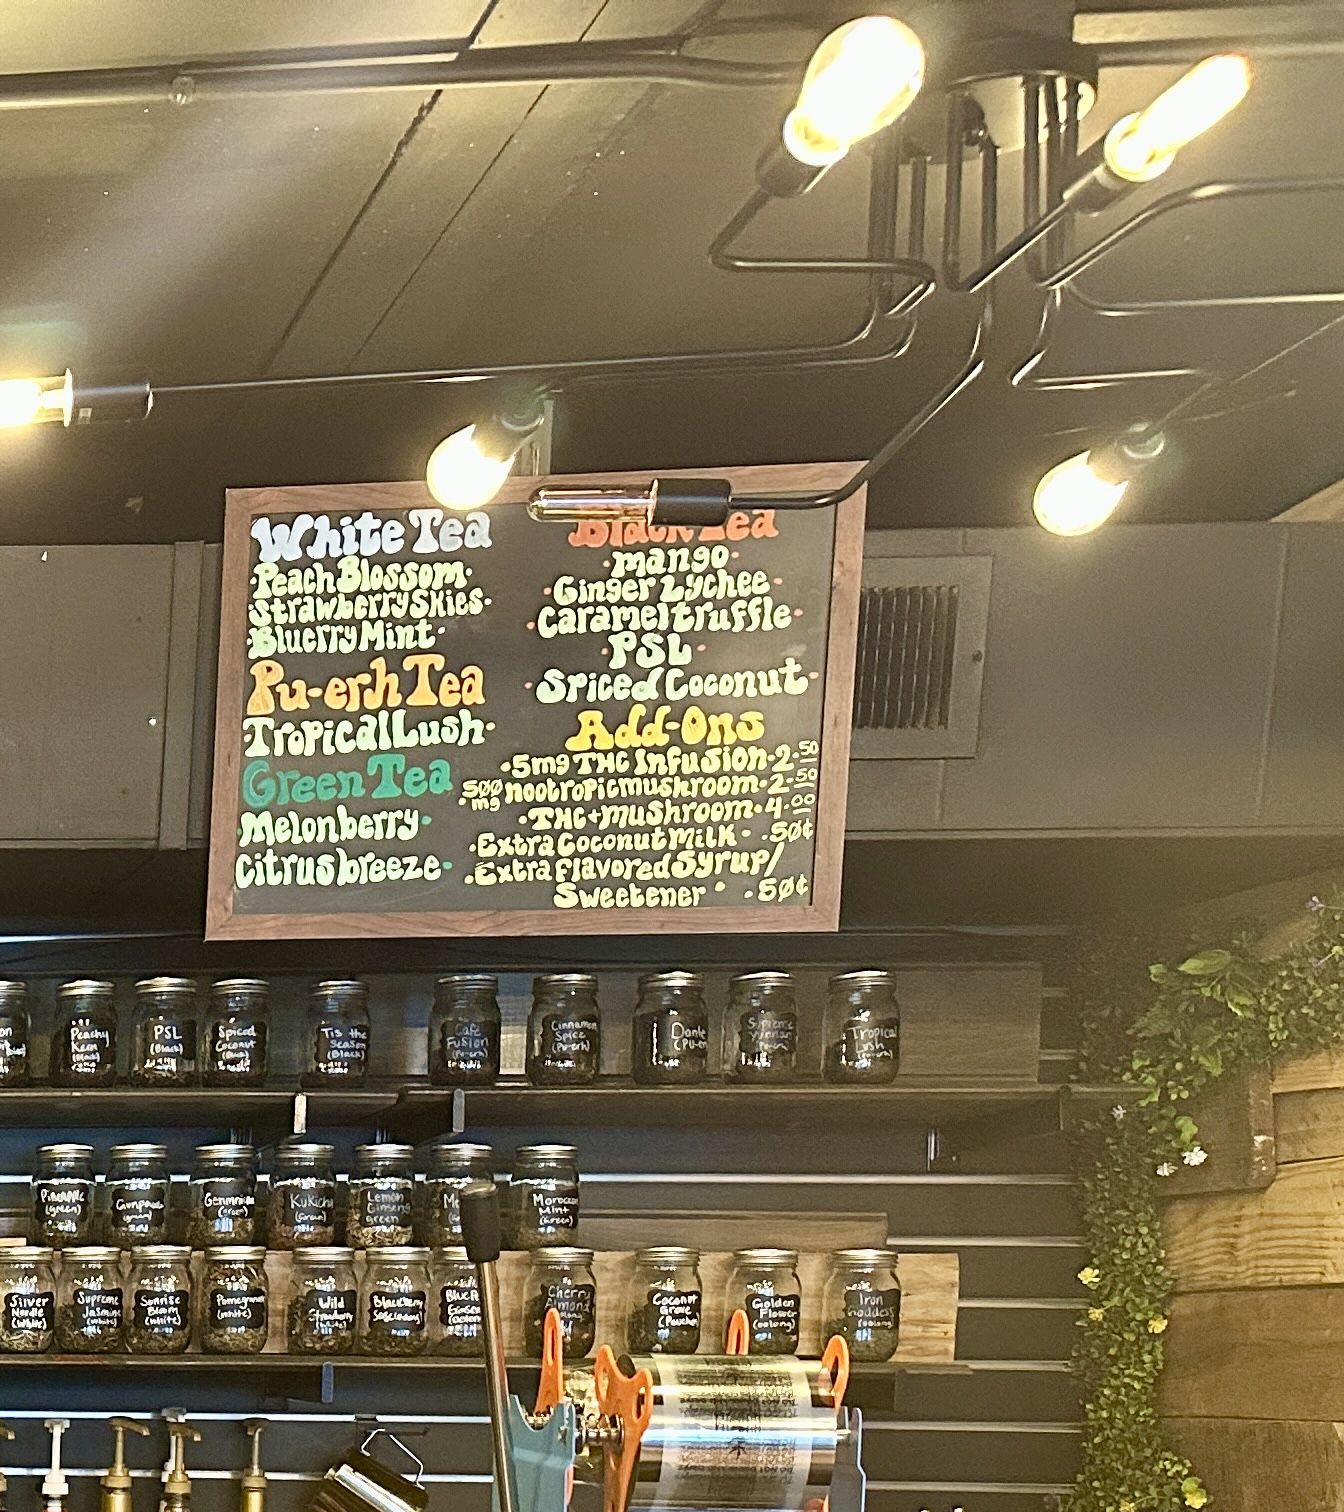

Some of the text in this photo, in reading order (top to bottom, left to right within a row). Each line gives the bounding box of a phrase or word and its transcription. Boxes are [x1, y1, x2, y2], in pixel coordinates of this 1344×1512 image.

[251, 509, 492, 563] White Tea
[253, 555, 467, 599] Peach Blossom
[611, 545, 729, 578] mango
[249, 588, 483, 626] Strawberry Skies
[553, 569, 770, 606] Ginger Lychee
[359, 619, 435, 651] Mint
[538, 596, 792, 639] Caramel truffle
[608, 630, 692, 670] PSL
[247, 654, 485, 715] Pu-erh Tea
[536, 657, 808, 703] Spiced Coconut
[243, 708, 486, 757] Tropical Lush
[565, 704, 765, 750] Add-Ons
[242, 753, 453, 807] Green Tea
[512, 747, 767, 778] 5mg THC Infusion
[478, 825, 737, 857] Extra Coconut Milk
[554, 883, 706, 908] Sweetener
